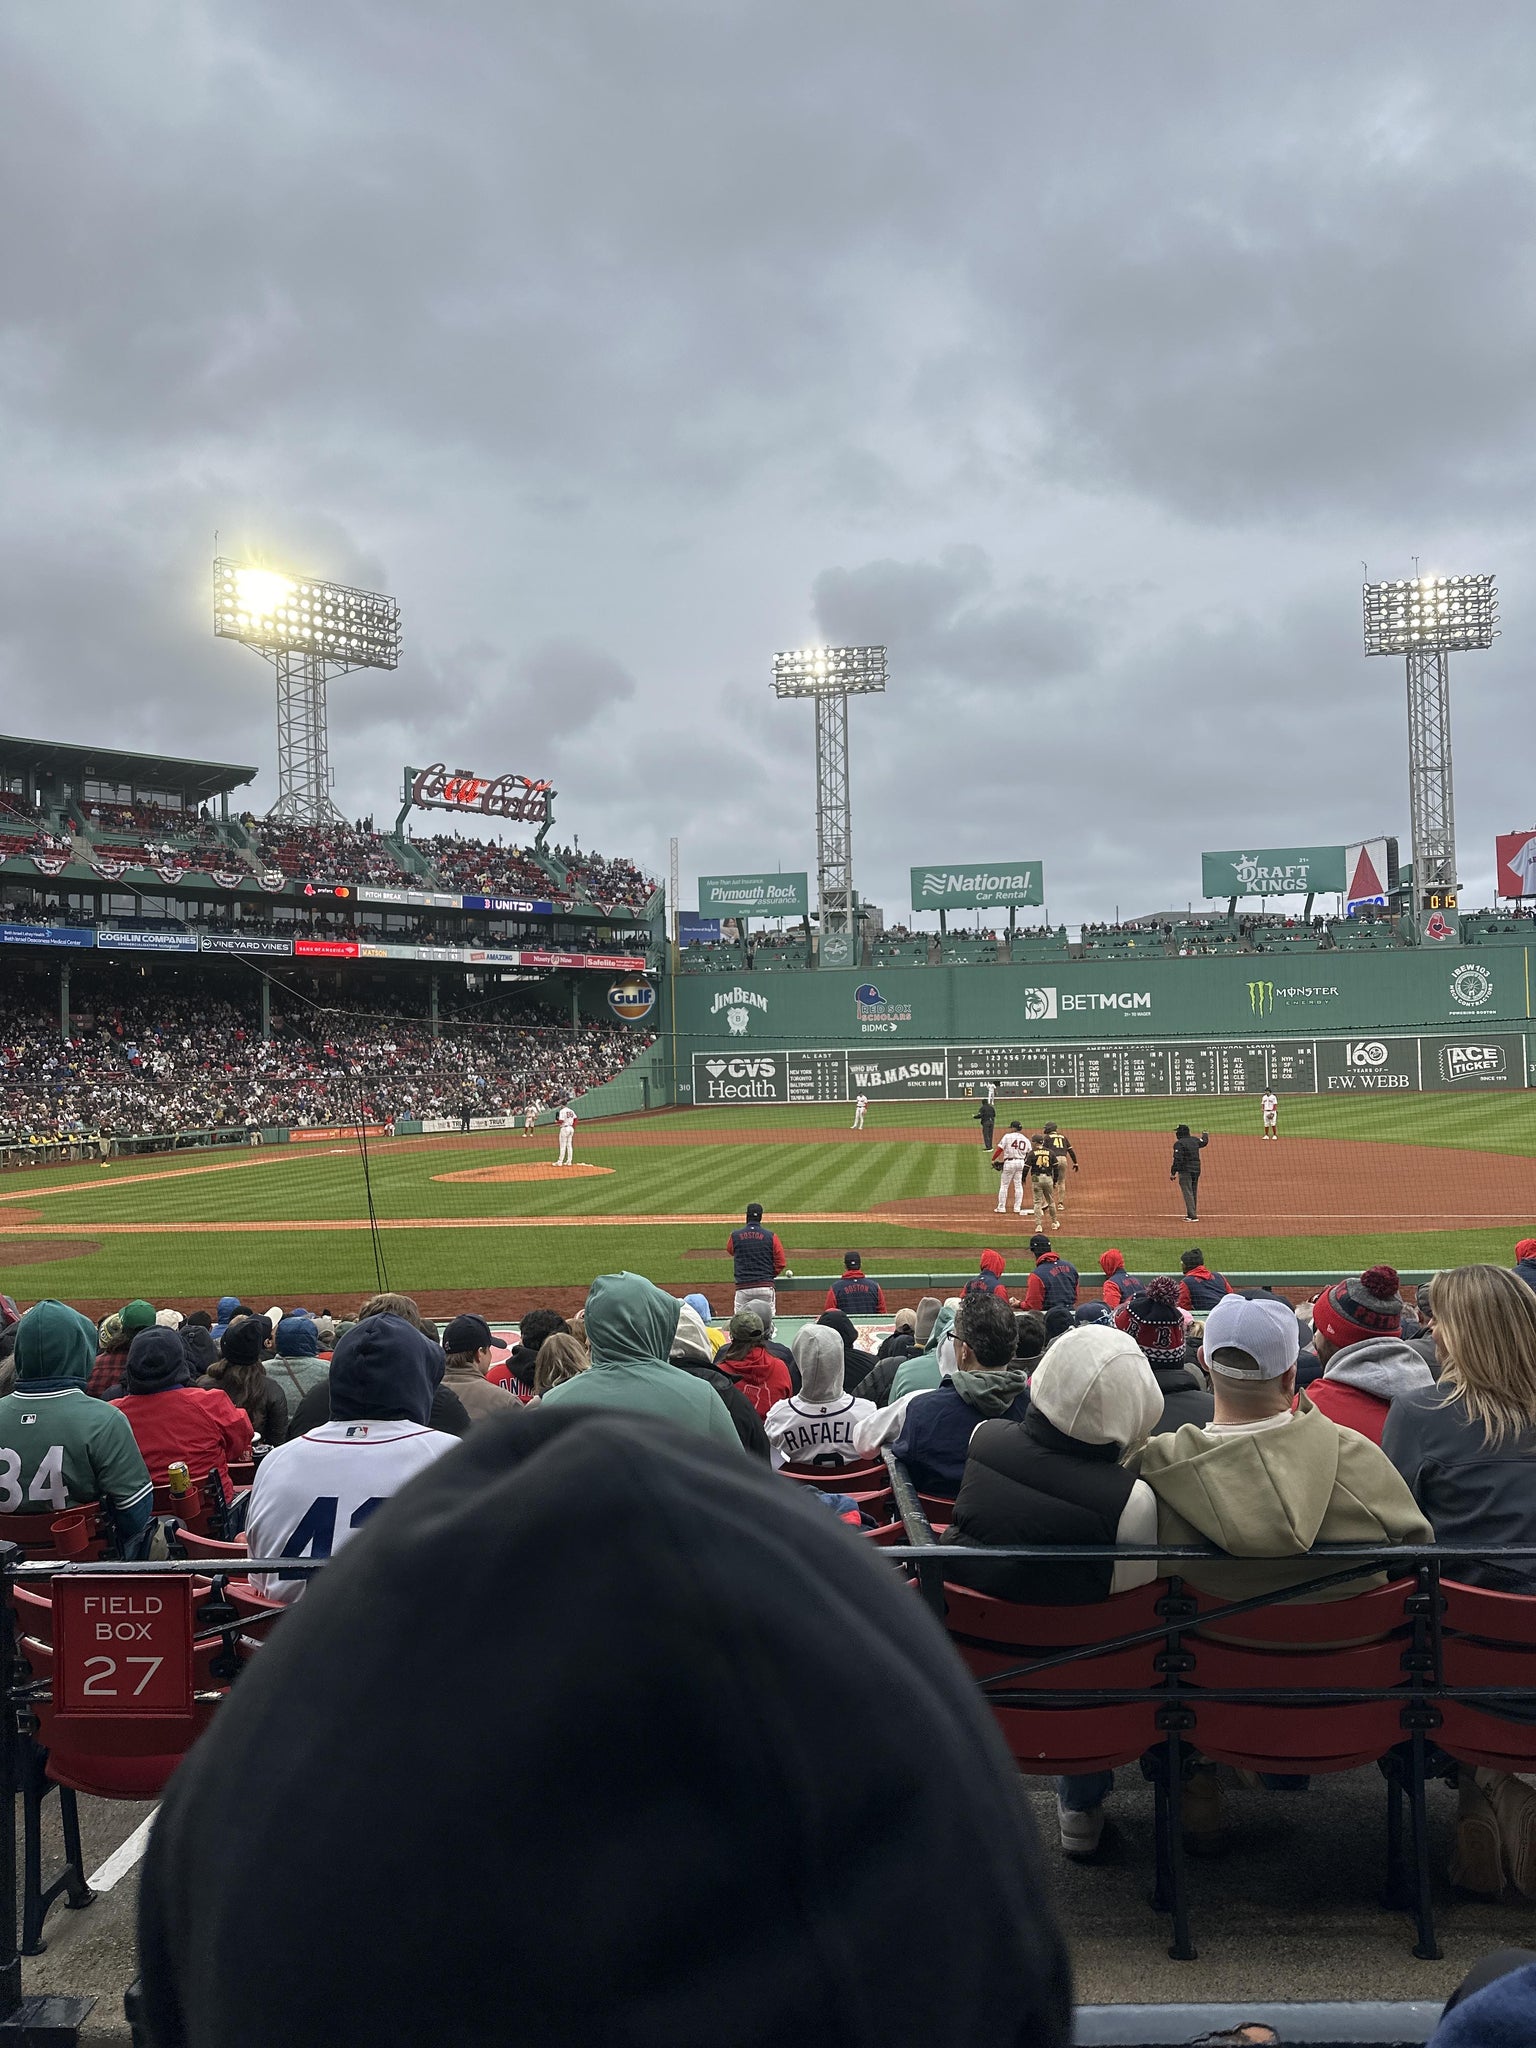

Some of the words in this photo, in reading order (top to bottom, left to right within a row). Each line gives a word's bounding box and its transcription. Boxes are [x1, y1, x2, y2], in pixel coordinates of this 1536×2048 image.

[413, 763, 553, 820] Coca-Cola
[1237, 865, 1309, 882] DRAFT
[947, 872, 1031, 891] National
[1246, 878, 1307, 892] KINGS
[365, 891, 381, 899] PITCH
[710, 886, 764, 900] Plymouth
[767, 885, 796, 897] Rock
[976, 892, 992, 900] Car
[995, 890, 1027, 900] Rental
[495, 900, 533, 911] UNITED
[100, 933, 141, 942] COGHLIN
[142, 935, 196, 944] COMPANIES
[213, 941, 259, 949] VINEYARD
[588, 959, 616, 967] Safelite
[609, 989, 652, 1004] Gulf
[1276, 987, 1339, 997] MONSTER
[710, 993, 733, 1014] JIM
[734, 987, 768, 1013] BEAM
[1061, 993, 1151, 1010] BETMGM
[862, 1005, 885, 1014] RED
[888, 1004, 912, 1013] SOX
[862, 1013, 912, 1021] SCHOLARS
[862, 1024, 888, 1032] BIDMC
[1346, 1042, 1388, 1065] 160
[1452, 1047, 1498, 1063] ACE
[728, 1058, 776, 1077] CVS
[1453, 1060, 1498, 1073] TICKET
[1328, 1075, 1357, 1088] F.W.
[1360, 1075, 1410, 1088] WEBB
[708, 1080, 776, 1098] Health
[965, 1087, 973, 1096] 13
[1011, 1140, 1026, 1151] 40
[1053, 1138, 1064, 1148] 41
[739, 1231, 764, 1240] BOSTON
[844, 1285, 869, 1294] BOSTON
[1153, 1326, 1171, 1348] B
[84, 1597, 162, 1614] FIELD
[95, 1623, 152, 1640] BOX
[83, 1656, 164, 1696] 27
